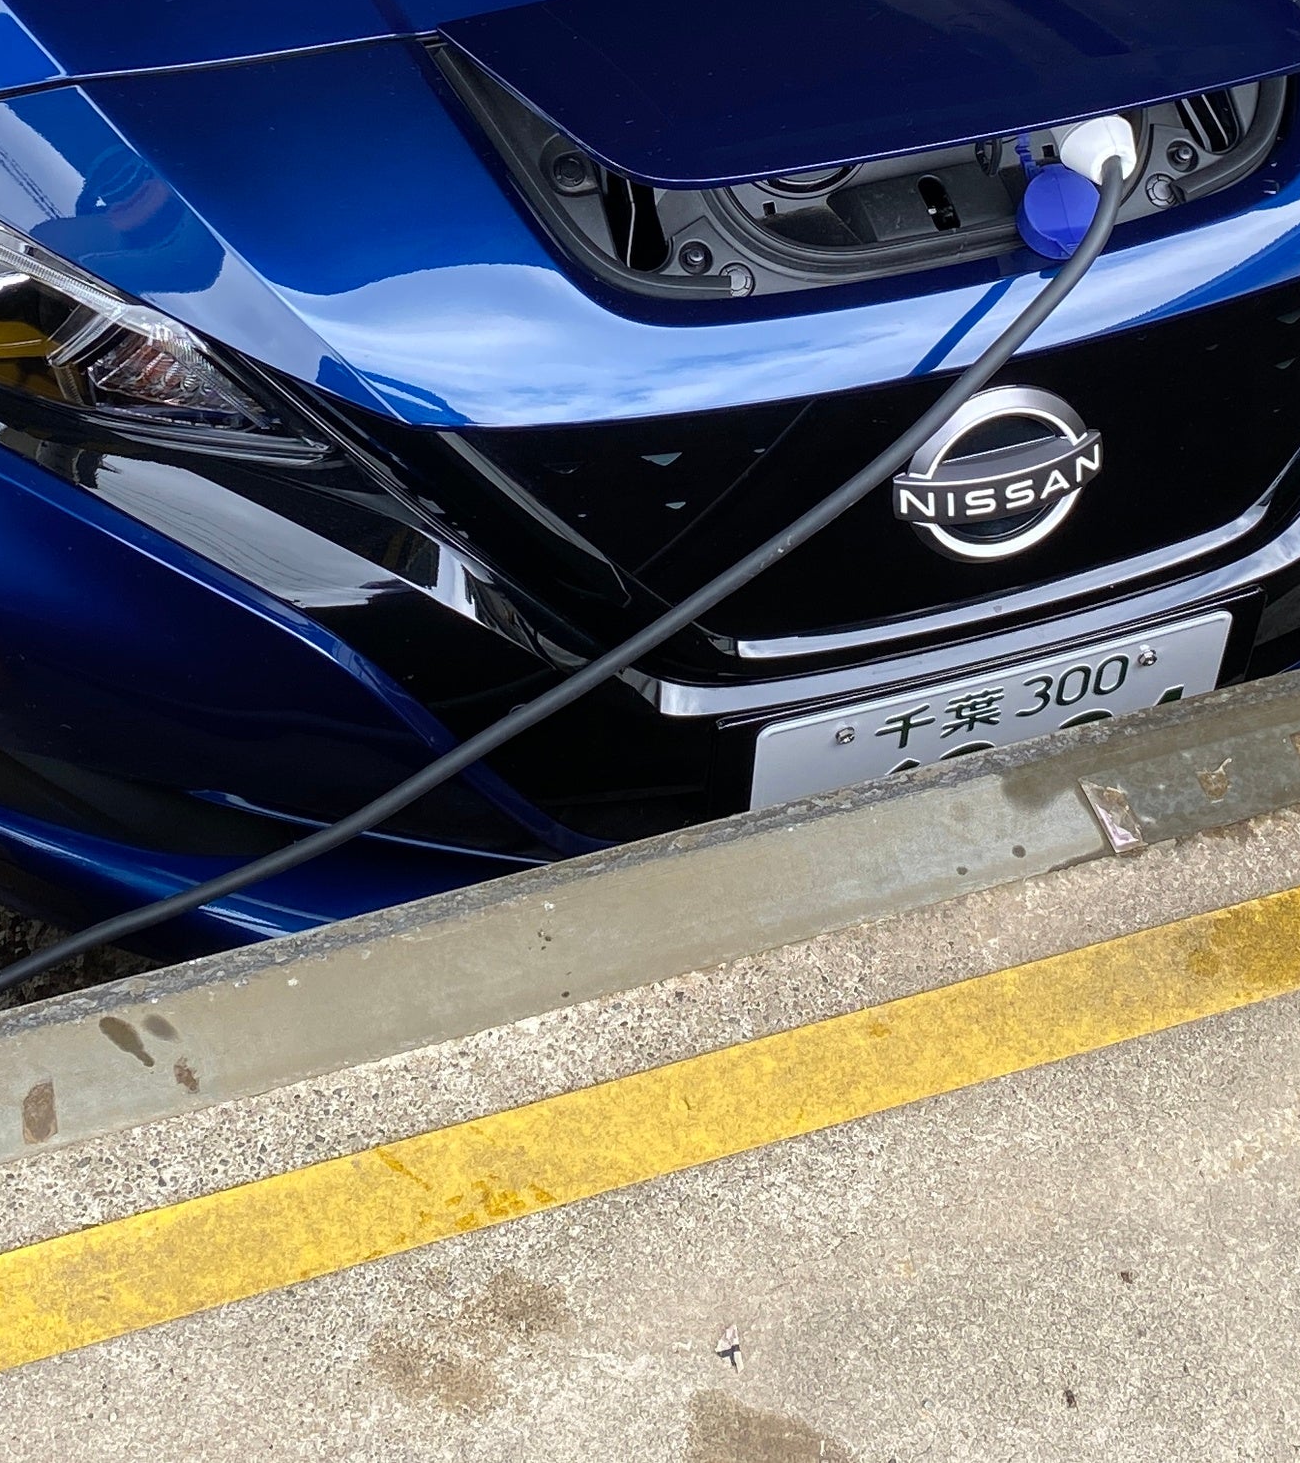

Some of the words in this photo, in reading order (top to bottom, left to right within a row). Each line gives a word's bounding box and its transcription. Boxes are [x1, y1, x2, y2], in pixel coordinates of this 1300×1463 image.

[900, 443, 1100, 517] NISSAN
[874, 687, 1004, 749] 千葉
[1015, 653, 1130, 717] 300
